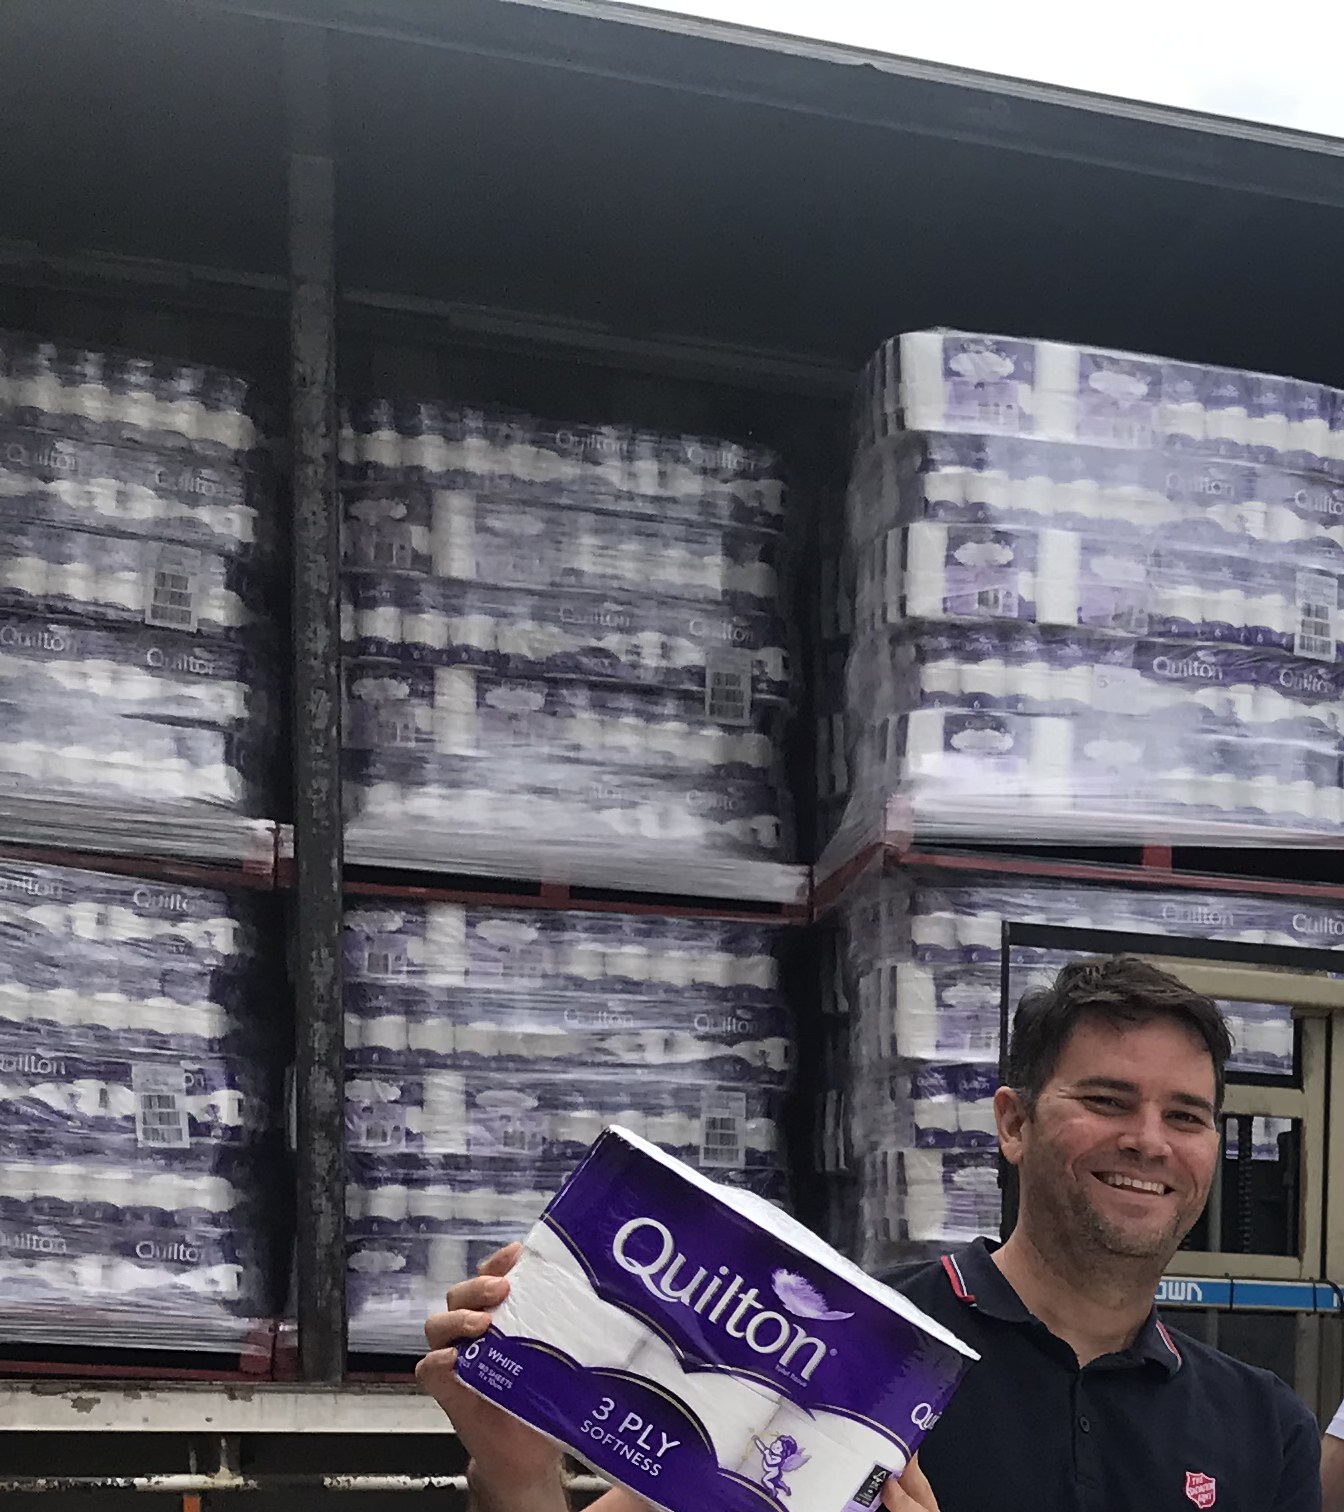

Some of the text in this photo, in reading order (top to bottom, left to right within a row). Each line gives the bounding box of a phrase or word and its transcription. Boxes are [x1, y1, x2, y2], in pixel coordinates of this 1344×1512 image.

[1152, 655, 1223, 682] Quilton
[133, 888, 191, 912] Quilto
[0, 1055, 66, 1077] uilton
[135, 1240, 201, 1263] Quilto
[612, 1216, 829, 1382] Quilton
[488, 1347, 523, 1377] WHITE
[592, 1398, 681, 1459] 3 PLY
[580, 1420, 663, 1478] SOFTNESS
